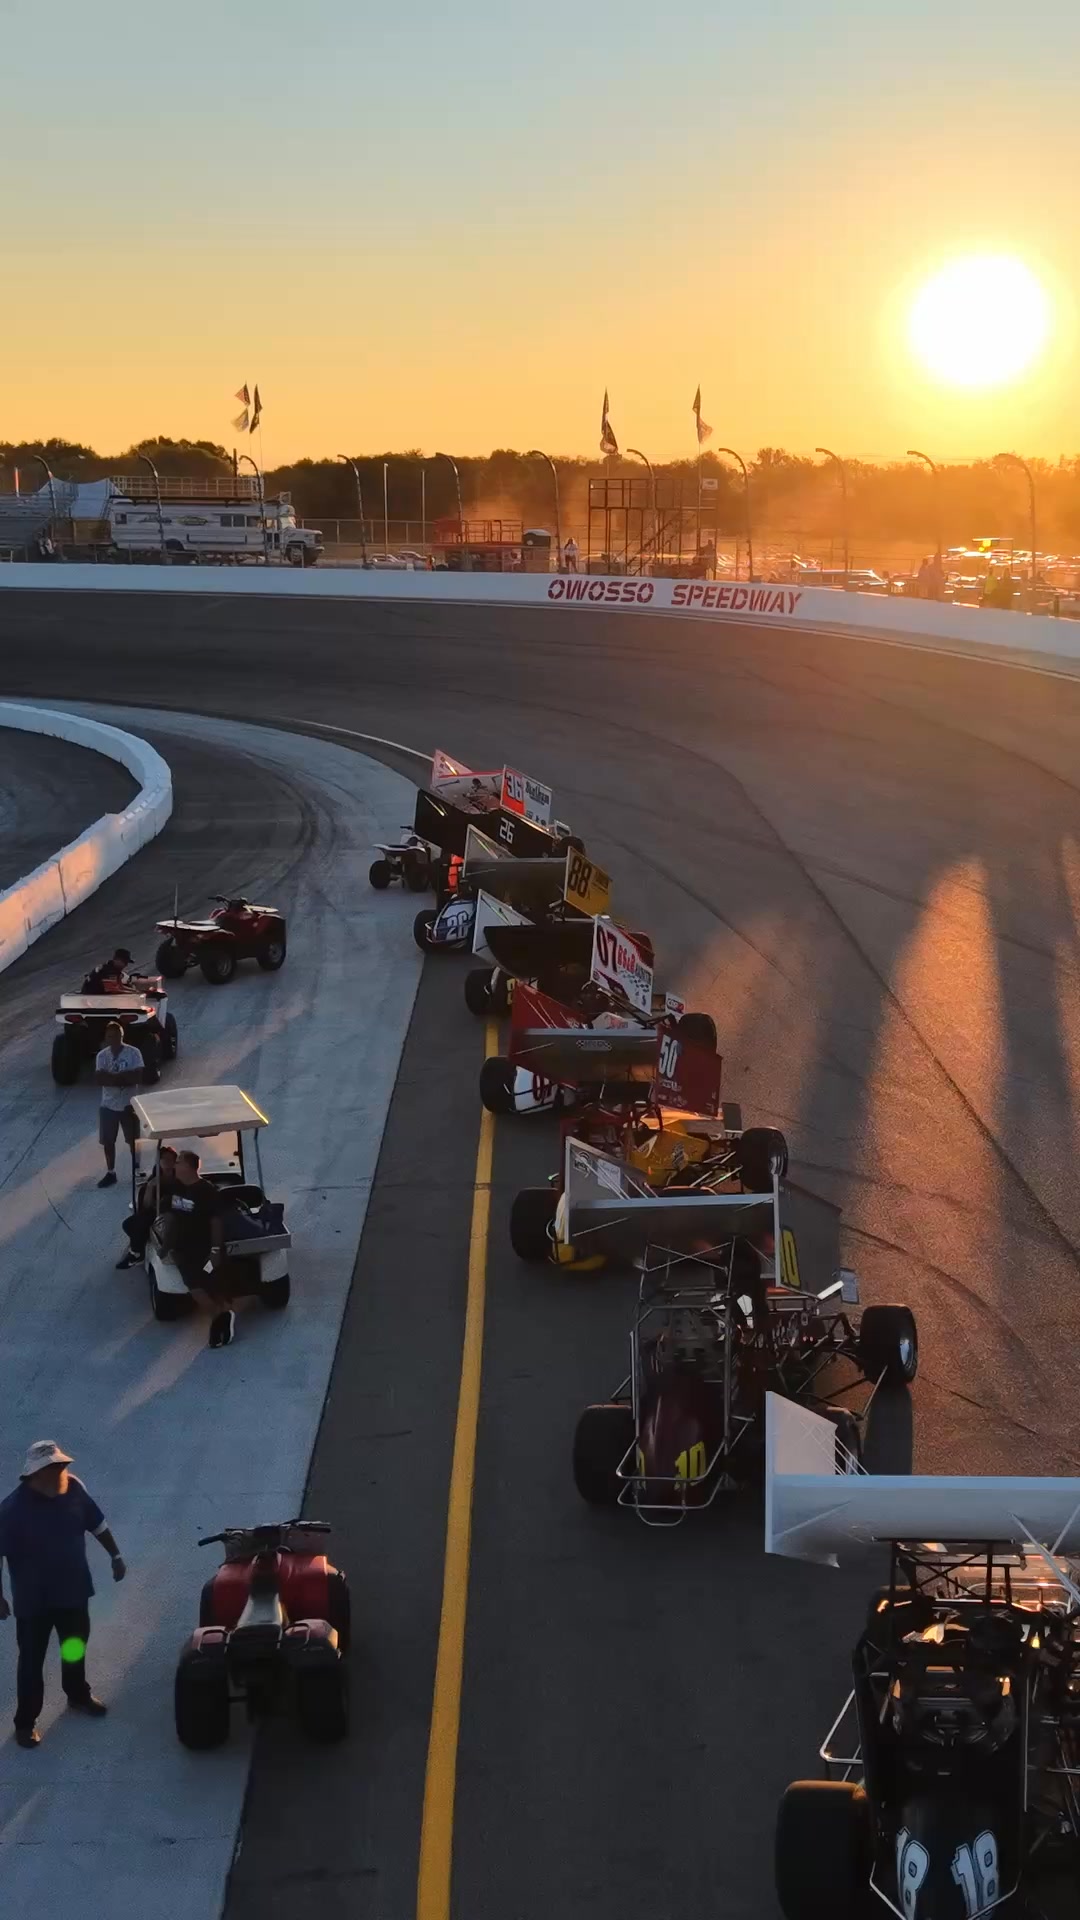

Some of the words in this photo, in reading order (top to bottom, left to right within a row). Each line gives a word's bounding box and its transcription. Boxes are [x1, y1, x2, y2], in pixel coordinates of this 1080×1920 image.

[547, 579, 655, 604] OWOSSO
[671, 584, 802, 615] SPEEDWAY
[499, 817, 515, 844] 26
[568, 855, 592, 899] 88
[597, 925, 618, 973] 07
[659, 1034, 679, 1078] 50
[950, 1830, 999, 1917] 18
